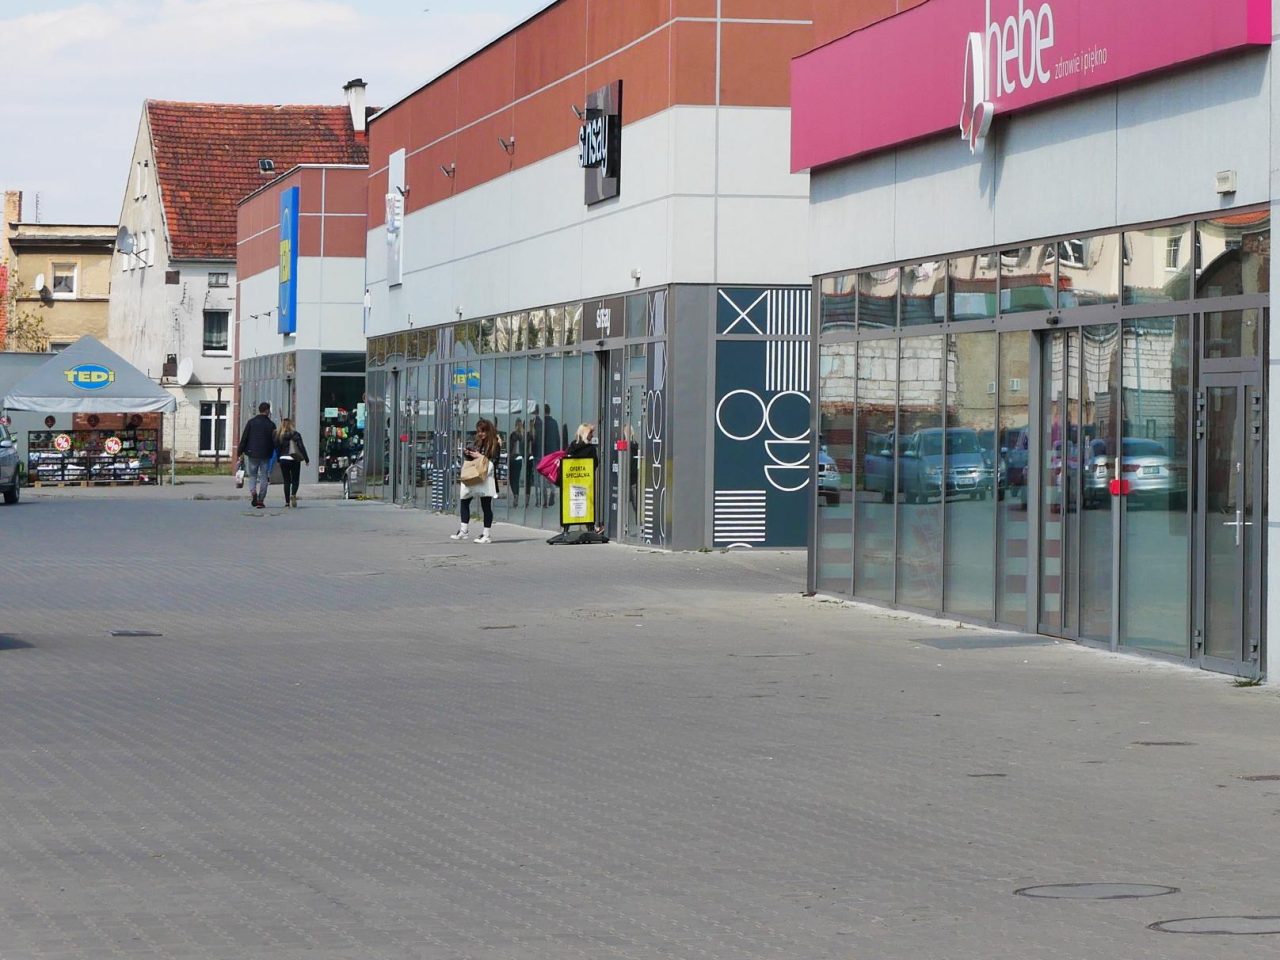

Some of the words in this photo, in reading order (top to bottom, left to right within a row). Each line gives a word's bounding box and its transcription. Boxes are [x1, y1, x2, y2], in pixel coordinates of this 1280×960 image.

[1055, 53, 1080, 80] zdrowie
[1084, 44, 1107, 76] piękno
[579, 114, 608, 178] sinsay
[64, 370, 115, 382] TEDi
